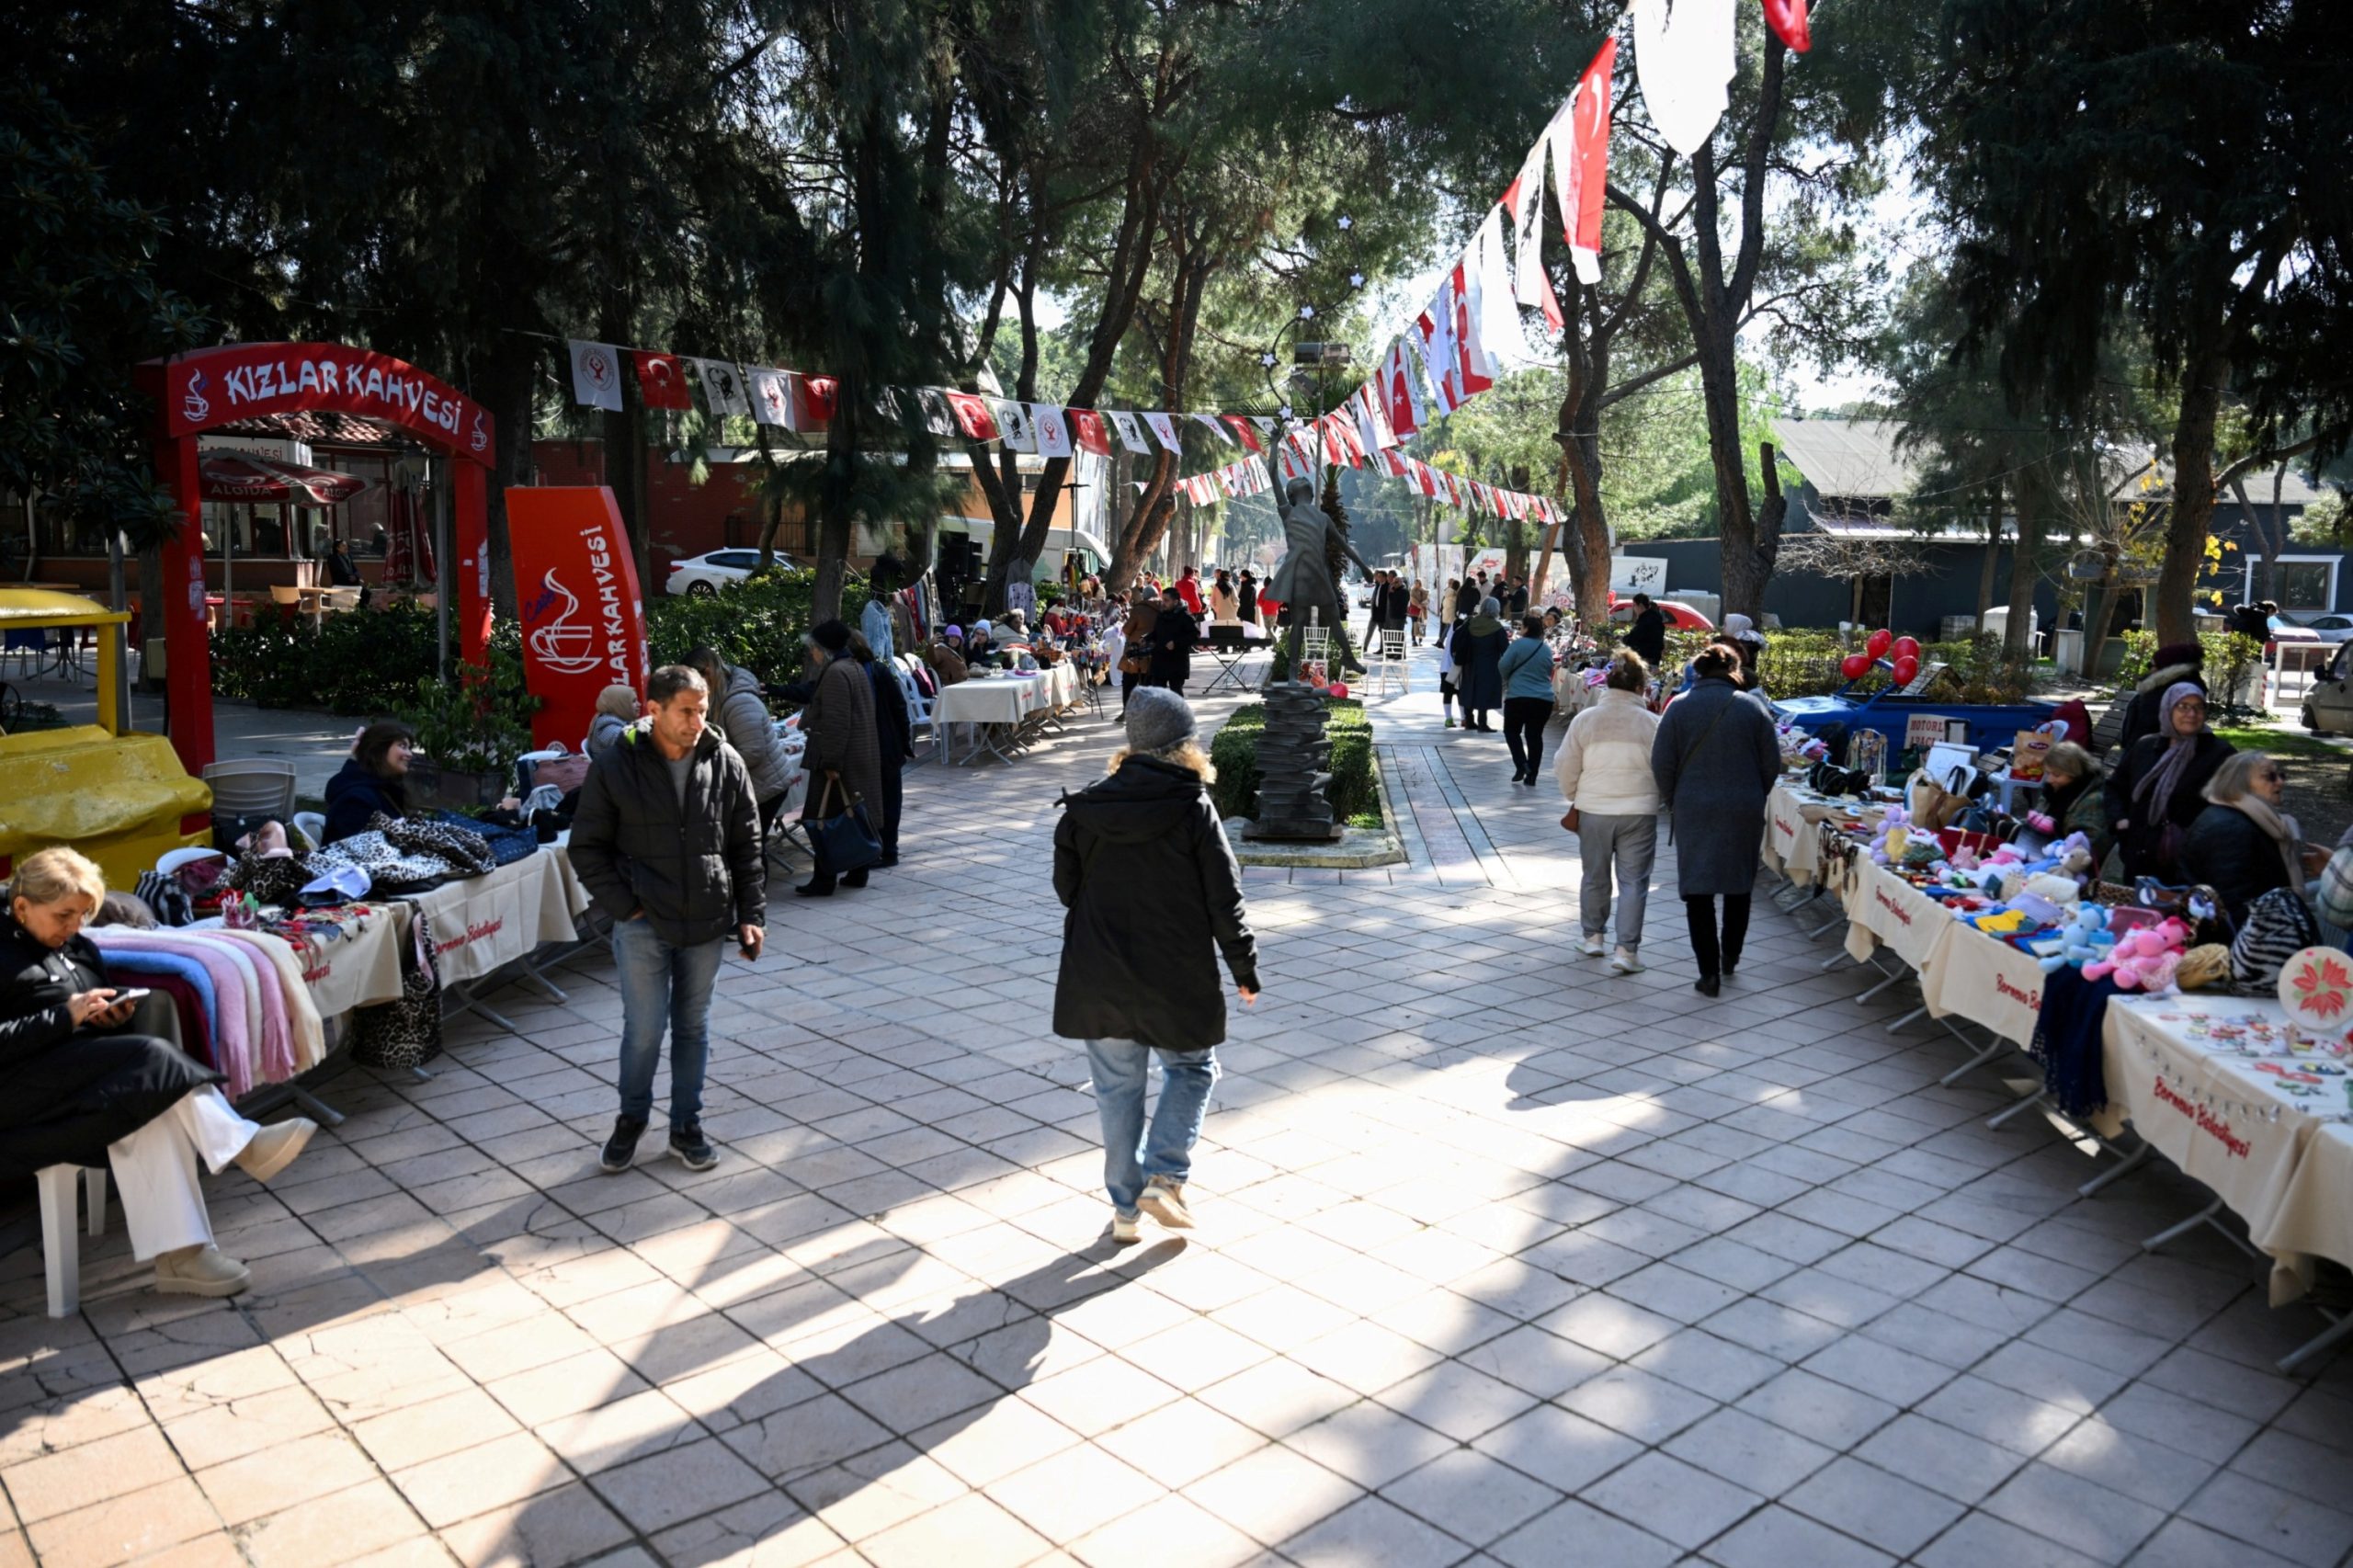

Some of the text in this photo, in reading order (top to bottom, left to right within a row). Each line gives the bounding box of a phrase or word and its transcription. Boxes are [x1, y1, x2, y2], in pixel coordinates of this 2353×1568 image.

[223, 359, 462, 435] KIZLAR KAHVESİ
[211, 483, 273, 496] ALGIDA
[580, 524, 631, 687] LAR KAHVESİ
[1910, 719, 1944, 733] MOTORL
[434, 934, 465, 956] ornova
[2154, 1074, 2251, 1159] Bornova Belediyesi
